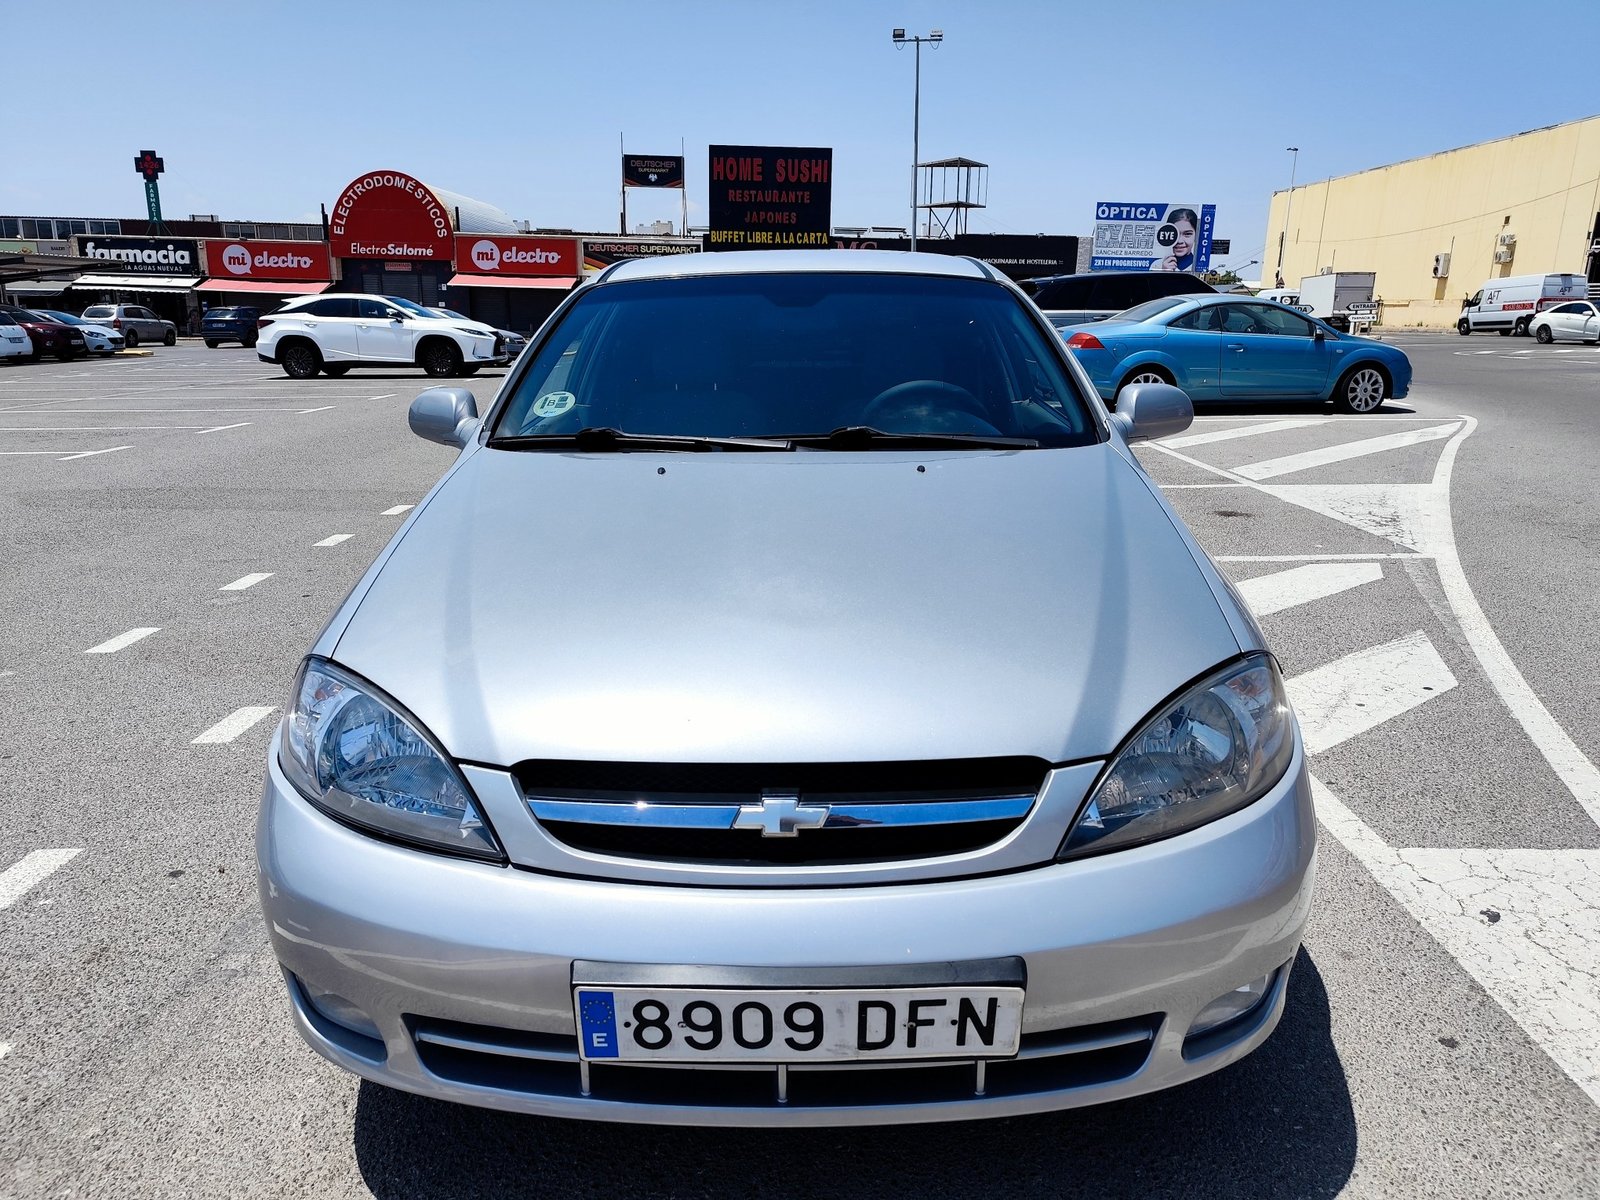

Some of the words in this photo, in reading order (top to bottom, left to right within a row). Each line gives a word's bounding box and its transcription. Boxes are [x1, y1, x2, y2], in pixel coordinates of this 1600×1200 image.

[630, 160, 676, 168] DEUTSCHER
[713, 157, 763, 182] HOME
[776, 158, 828, 183] SUSHI
[149, 183, 158, 221] FARMACIA
[728, 189, 811, 203] RESTAURANTE
[334, 175, 448, 238] ELECTRODOMÉSTICOS
[1098, 204, 1158, 219] ÓPTICA
[745, 211, 797, 224] JAPONES
[710, 230, 745, 243] BUFFET
[747, 231, 773, 244] LIBRE
[775, 232, 781, 244] A
[783, 232, 795, 244] LA
[796, 232, 829, 244] CARTA
[1159, 231, 1175, 240] EYE
[85, 242, 191, 264] farmacia
[351, 242, 434, 256] ElectroSalomé
[476, 249, 496, 262] mi
[502, 247, 561, 263] electro
[588, 244, 639, 252] DEUTSCHER
[640, 245, 697, 254] SUPERMARKT
[228, 254, 248, 267] mi
[254, 252, 313, 269] electro
[1112, 259, 1150, 267] PROGRESIVOS
[631, 998, 824, 1052] 8909
[857, 997, 999, 1051] DFN
[593, 1032, 608, 1048] E
